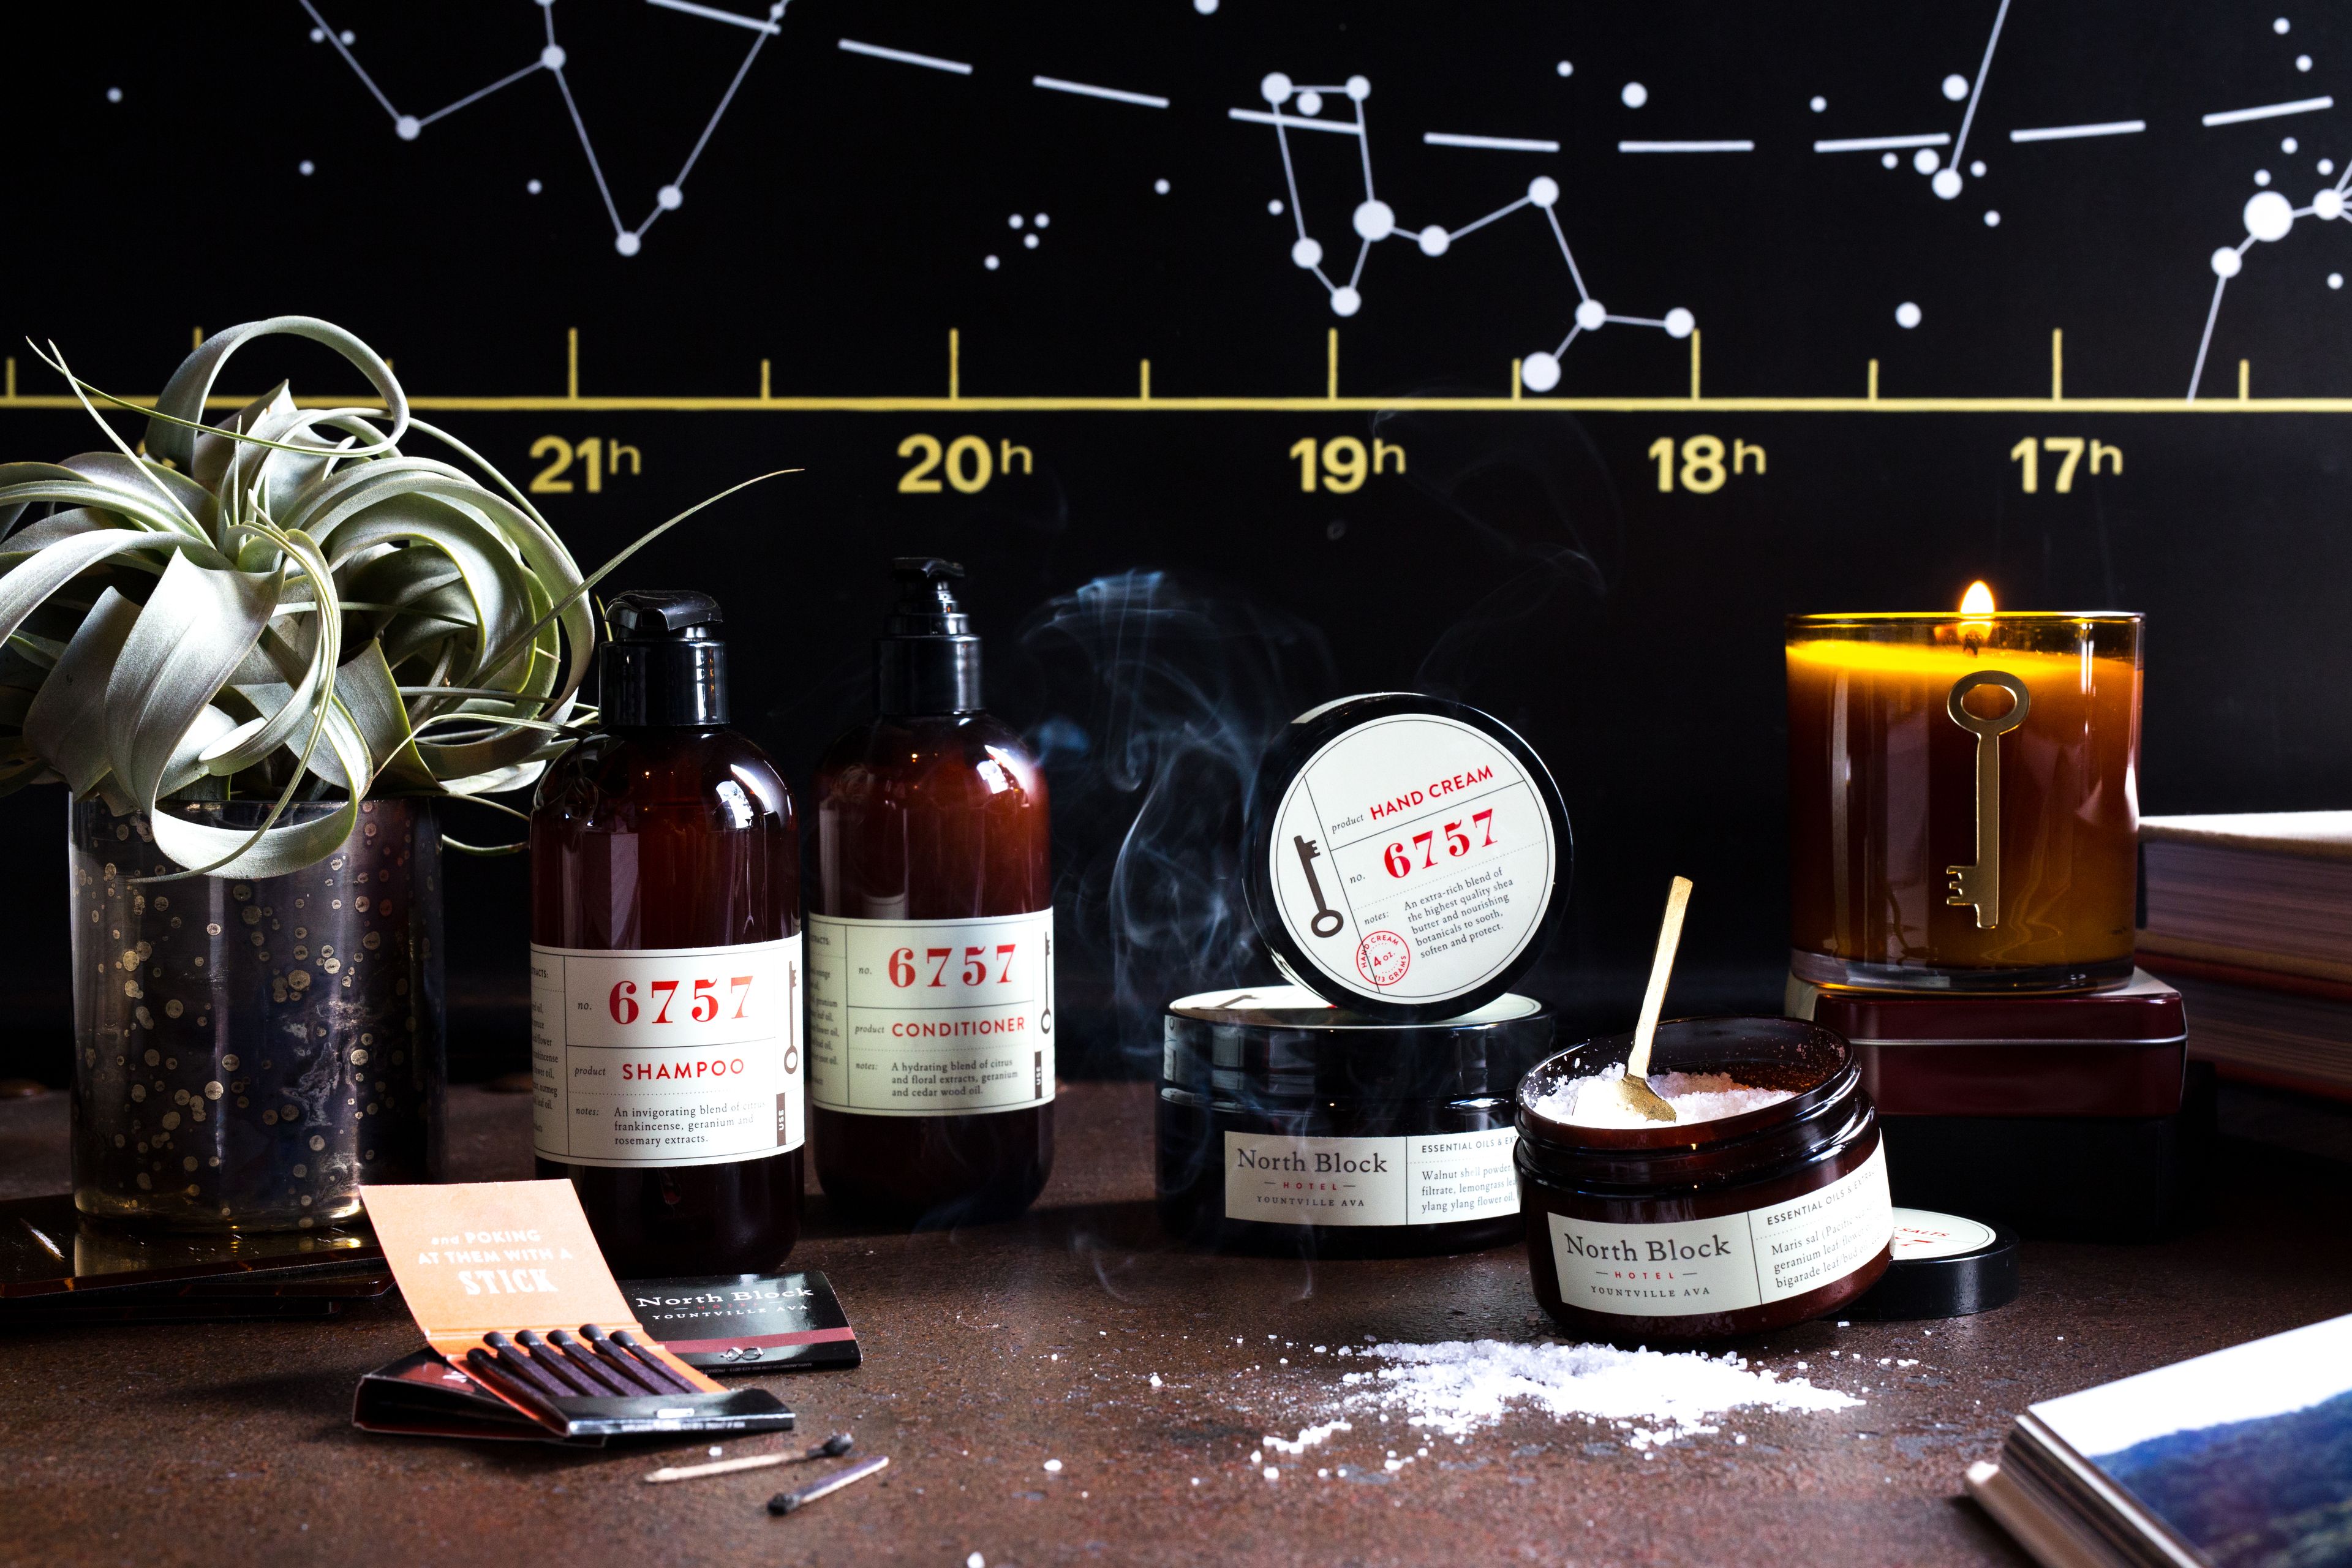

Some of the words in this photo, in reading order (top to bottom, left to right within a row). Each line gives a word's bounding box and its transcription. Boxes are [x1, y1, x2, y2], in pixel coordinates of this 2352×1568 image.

[1332, 815, 1364, 834] product
[1370, 791, 1423, 820] HAND
[1429, 765, 1493, 797] CREAM
[1349, 874, 1365, 883] no.
[1384, 809, 1498, 878] 6757
[1404, 902, 1417, 911] An
[1420, 882, 1464, 904] extra-rich
[1465, 872, 1491, 888] blend
[1494, 867, 1503, 877] of
[1408, 912, 1423, 922] the
[1425, 899, 1458, 915] highest
[1460, 888, 1491, 905] quality
[1493, 879, 1513, 891] shea
[1365, 911, 1389, 925] notes:
[1411, 919, 1439, 934] butter
[1442, 910, 1459, 923] and
[1461, 894, 1510, 916] nourishing
[1415, 923, 1462, 946] botanicals
[1476, 909, 1503, 925] sooth,
[1420, 941, 1448, 959] soften
[1451, 935, 1468, 947] and
[1469, 923, 1503, 942] protect.
[1360, 944, 1370, 968] HAND
[1371, 935, 1399, 946] CREAM
[859, 967, 872, 975] no.
[888, 944, 1016, 988] 6757
[1374, 956, 1382, 967] 4
[1389, 956, 1406, 981] GRAMS
[578, 1001, 592, 1011] no.
[609, 975, 753, 1025] 6757
[855, 1023, 884, 1034] product
[892, 1017, 1025, 1038] CONDITIONER
[575, 1066, 606, 1077] product
[622, 1058, 744, 1080] SHAMPOO
[856, 1062, 878, 1071] notes:
[892, 1063, 899, 1071] A
[902, 1062, 948, 1073] hydrating
[951, 1060, 976, 1071] blend
[980, 1060, 988, 1069] of
[991, 1058, 1012, 1068] citrus
[892, 1075, 908, 1084] and
[912, 1074, 936, 1084] floral
[982, 1071, 1017, 1084] geranium
[892, 1088, 908, 1096] and
[912, 1087, 937, 1096] cedar
[941, 1086, 966, 1096] wood
[969, 1085, 983, 1095] oil.
[576, 1107, 599, 1116] notes:
[614, 1107, 628, 1117] An
[632, 1106, 696, 1120] invigorating
[699, 1103, 728, 1115] blend
[731, 1102, 740, 1112] of
[614, 1120, 684, 1131] frankincense,
[688, 1118, 734, 1132] geranium
[738, 1114, 753, 1125] and
[615, 1136, 661, 1147] rosemary
[665, 1135, 709, 1144] extracts.
[1422, 1142, 1472, 1153] ESSENTIAL
[1476, 1139, 1494, 1148] OILS
[1505, 1136, 1517, 1144] EXT
[1238, 1148, 1306, 1172] North
[1314, 1153, 1388, 1173] Block
[1422, 1170, 1457, 1180] Walnut
[1283, 1182, 1338, 1191] HOTEL
[1422, 1186, 1456, 1196] filtrate,
[1460, 1181, 1504, 1193] lemongrass
[1507, 1177, 1517, 1186] lea
[1257, 1196, 1334, 1206] YOUNTVILLE
[1422, 1201, 1448, 1214] ylang
[1451, 1199, 1474, 1212] ylang
[1477, 1196, 1502, 1206] flower
[1767, 1200, 1823, 1226] ESSENTIAL
[1826, 1189, 1845, 1205] OILS
[431, 1235, 459, 1245] and
[464, 1229, 541, 1244] POKING
[1899, 1228, 1951, 1237] SALTS
[1566, 1234, 1637, 1262] North
[1648, 1234, 1732, 1262] Block
[1771, 1239, 1803, 1255] Maris
[1806, 1231, 1819, 1245] sal
[419, 1252, 439, 1265] AT
[443, 1250, 500, 1264] THEM
[503, 1248, 554, 1262] WITH
[560, 1248, 573, 1259] A
[1774, 1250, 1821, 1275] geranium
[458, 1268, 559, 1295] STICK
[1615, 1271, 1675, 1280] HOTEL
[1776, 1267, 1821, 1288] bigarade
[636, 1293, 723, 1307] North
[731, 1287, 814, 1301] Block
[1591, 1285, 1676, 1297] YOUNTVILLE
[1684, 1286, 1710, 1296] AVA
[652, 1308, 767, 1320] YOUNTVILLE
